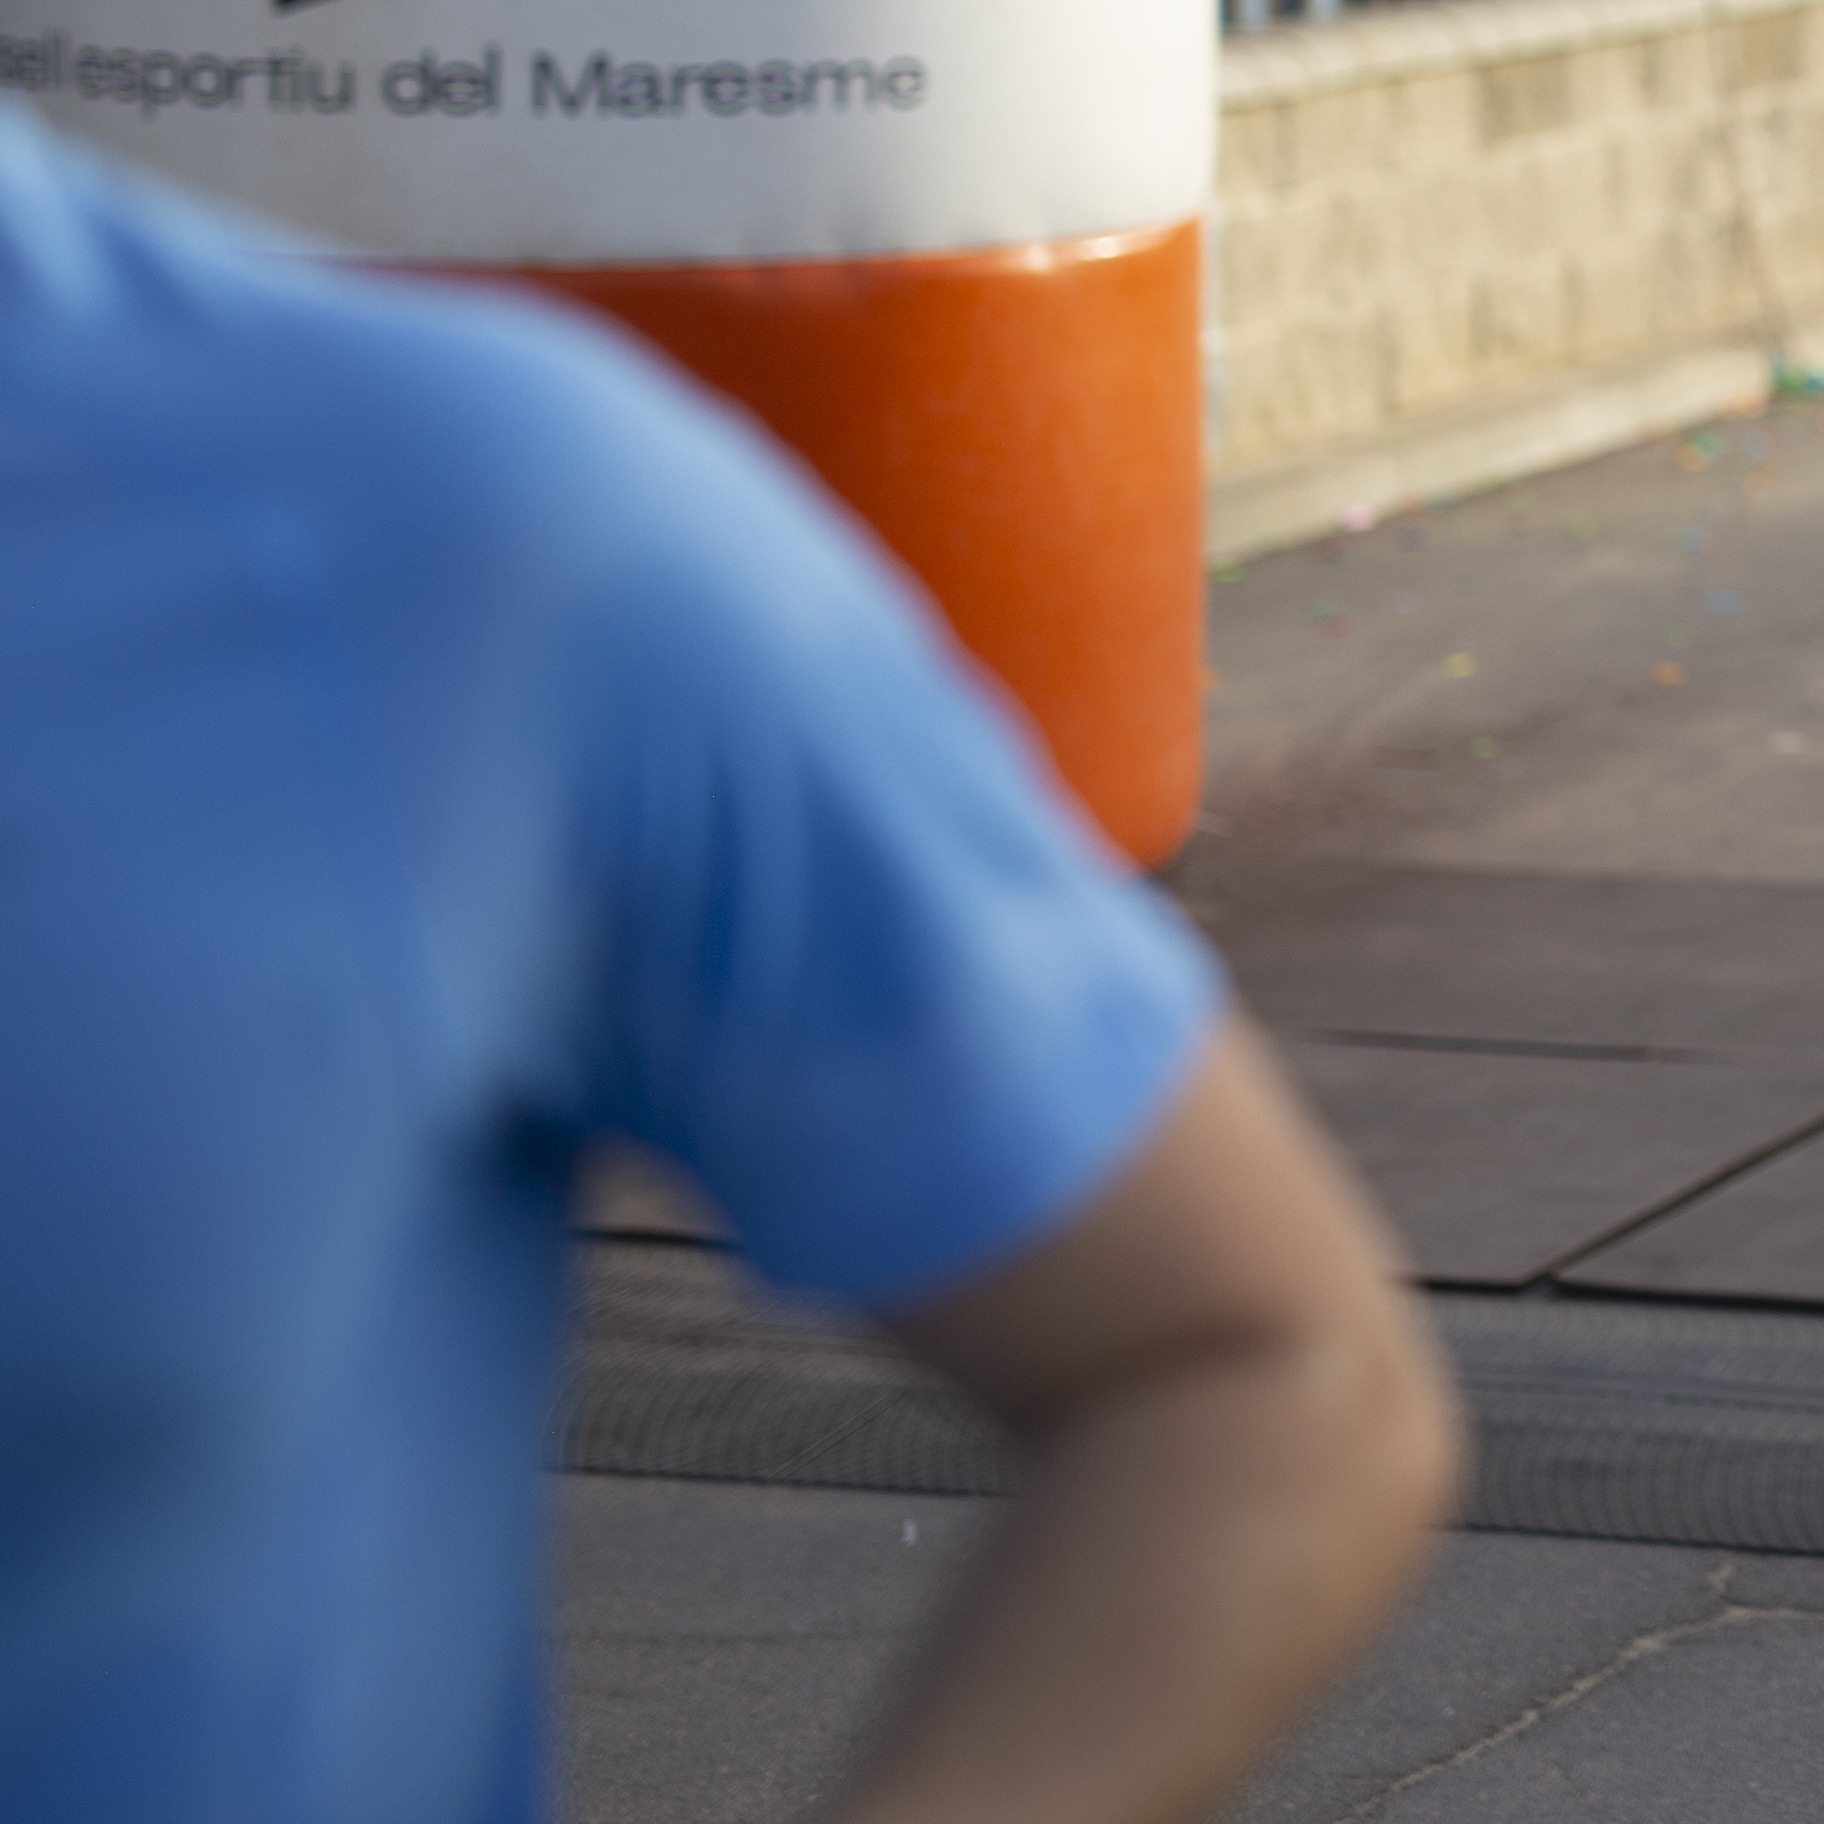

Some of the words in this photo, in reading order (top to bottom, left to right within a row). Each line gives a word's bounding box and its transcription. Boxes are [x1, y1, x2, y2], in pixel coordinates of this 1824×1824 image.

[75, 38, 356, 119] esportiu
[379, 39, 504, 119] del
[530, 48, 928, 119] Maresme
